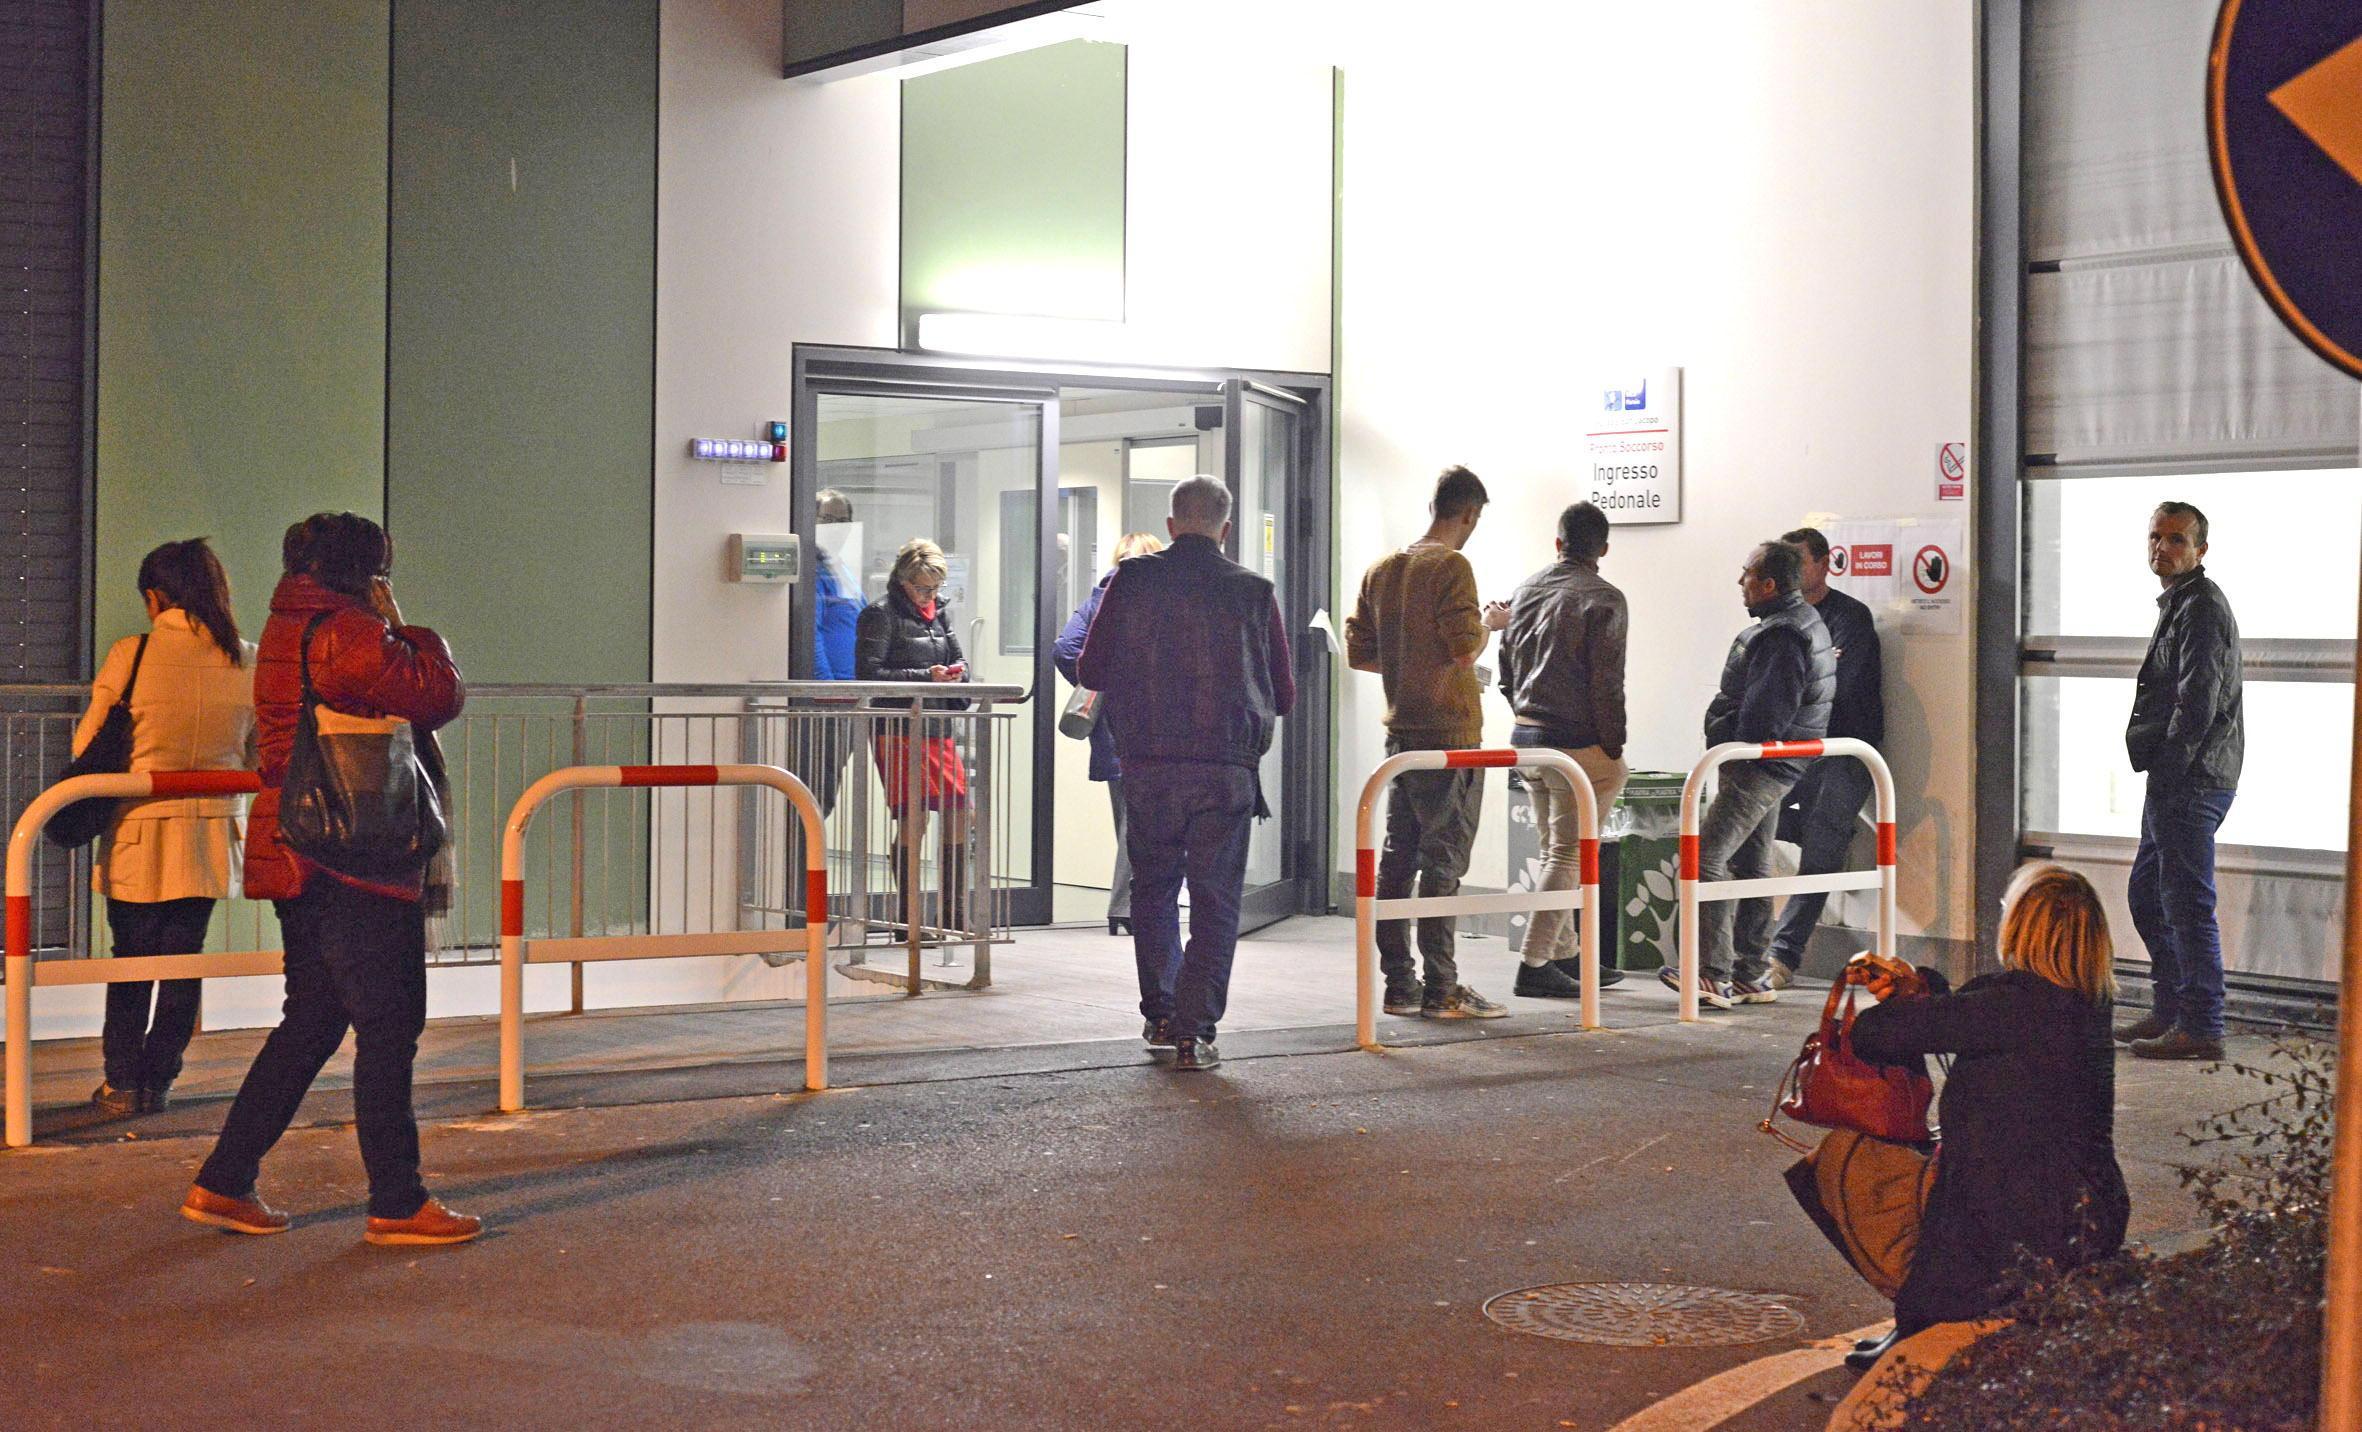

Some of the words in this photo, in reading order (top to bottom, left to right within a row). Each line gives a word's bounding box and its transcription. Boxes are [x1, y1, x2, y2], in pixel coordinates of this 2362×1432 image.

[1619, 441, 1665, 453] Soccorso
[1593, 463, 1658, 486] Ingresso
[1591, 489, 1661, 509] Pedonale
